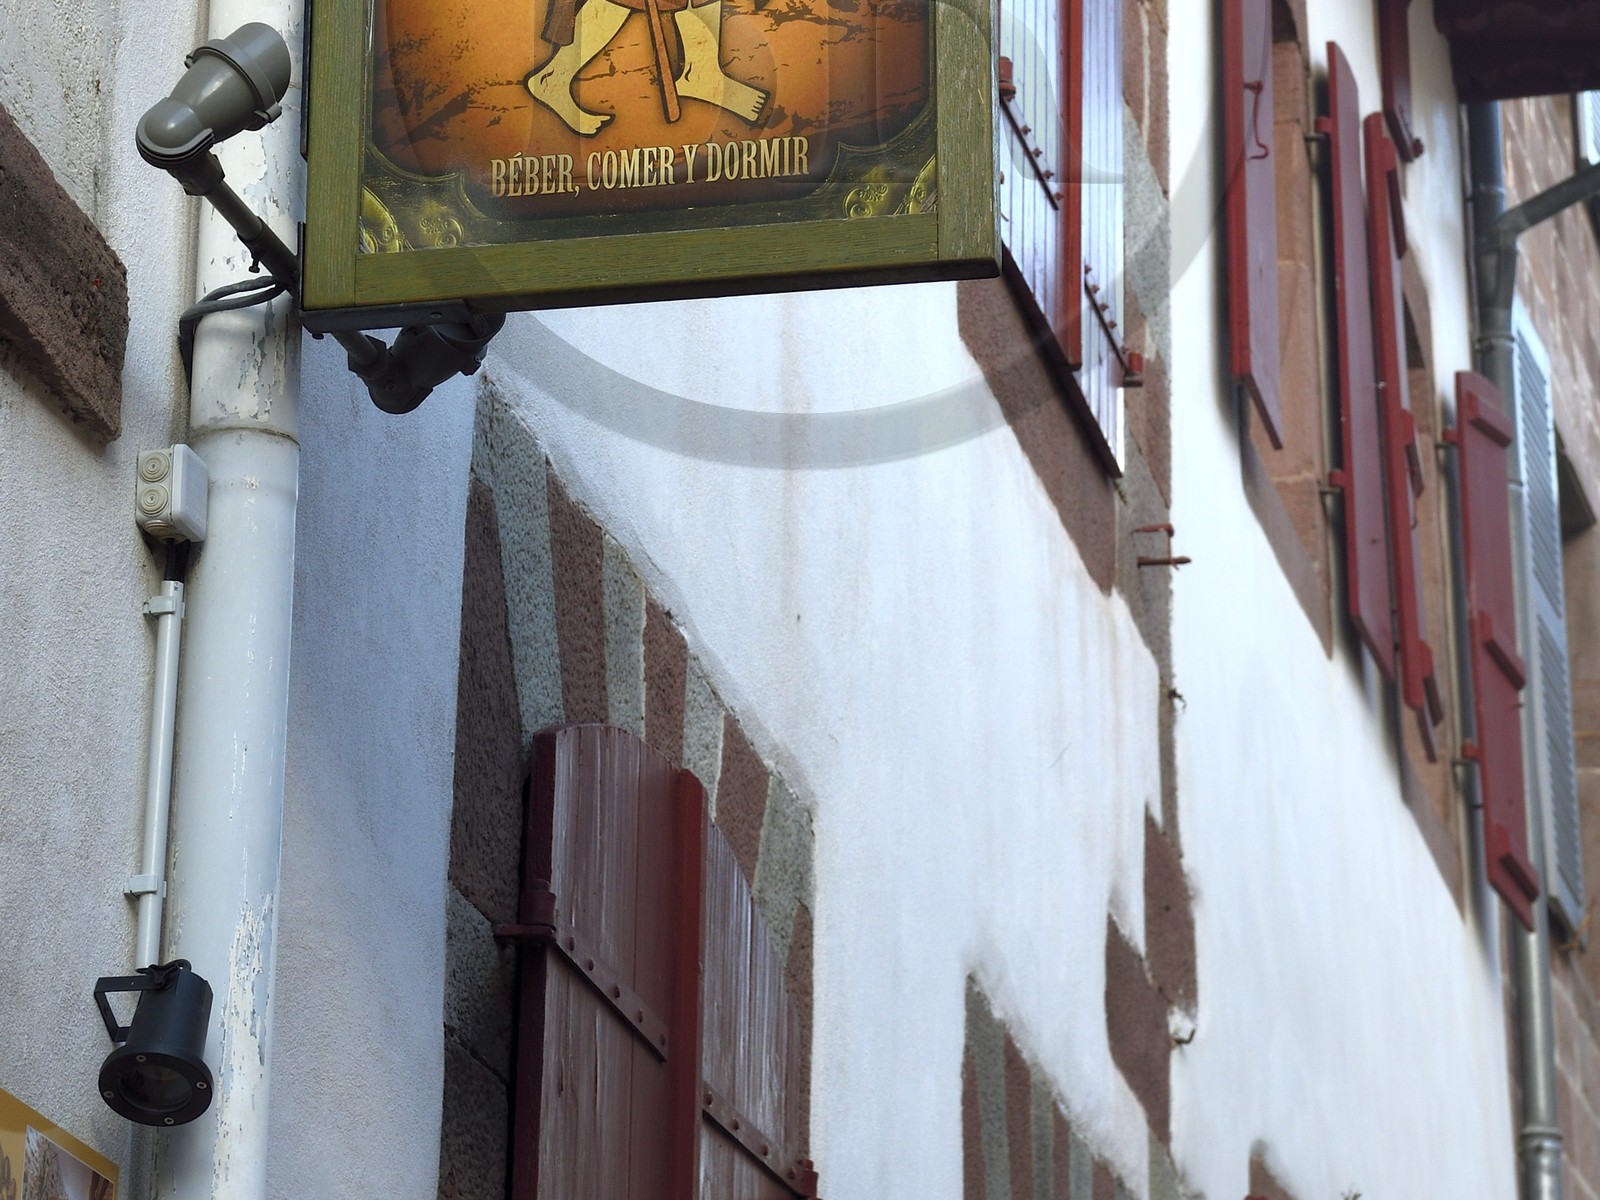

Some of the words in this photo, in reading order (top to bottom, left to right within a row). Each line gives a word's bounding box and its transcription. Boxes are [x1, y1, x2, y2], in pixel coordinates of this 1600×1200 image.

[490, 152, 580, 198] BÉBER,
[587, 146, 677, 191] COMER
[682, 144, 700, 185] Y
[705, 136, 810, 183] DORMIR
